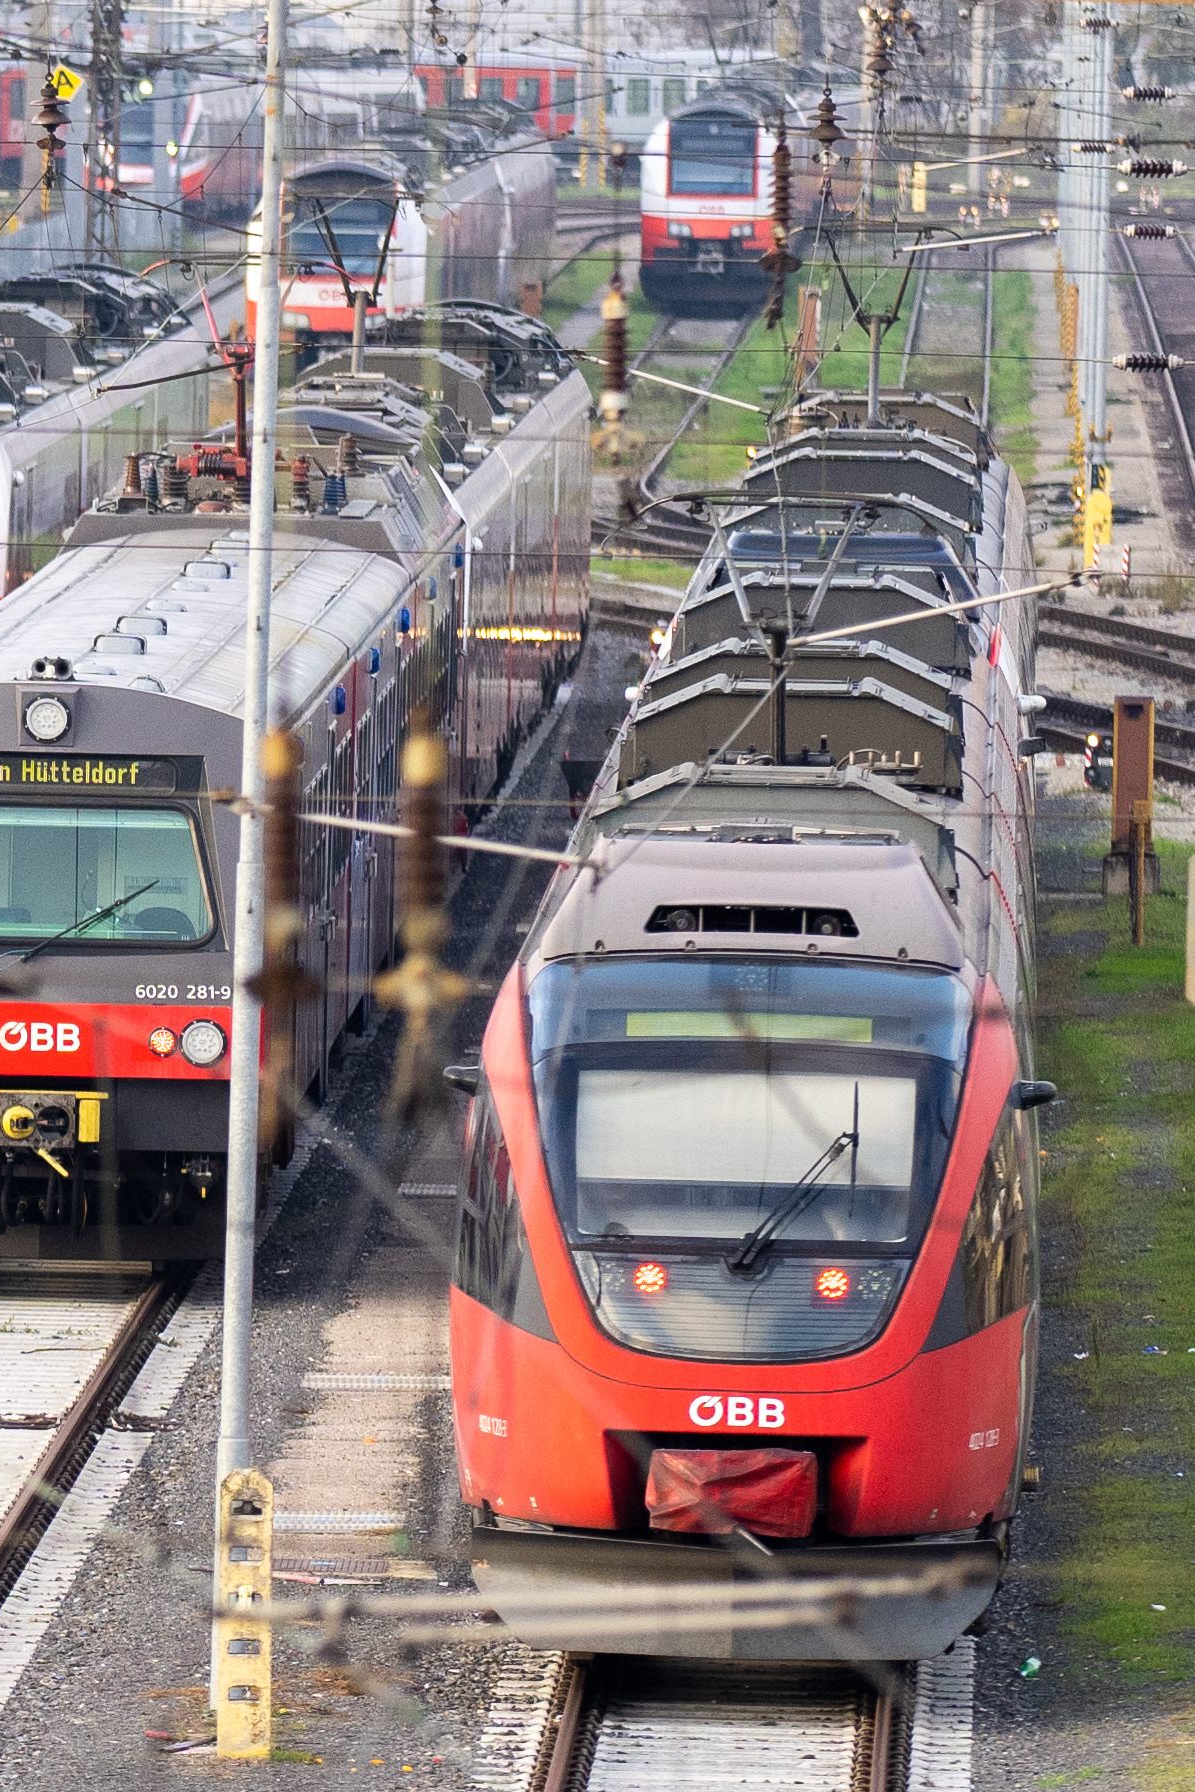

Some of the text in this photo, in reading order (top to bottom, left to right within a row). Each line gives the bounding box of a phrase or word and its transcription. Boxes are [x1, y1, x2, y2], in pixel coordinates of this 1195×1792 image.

[56, 70, 75, 90] A
[21, 759, 139, 785] Hütteldorf
[135, 984, 232, 1000] 6020 281-9
[688, 1395, 786, 1429] ÖBB
